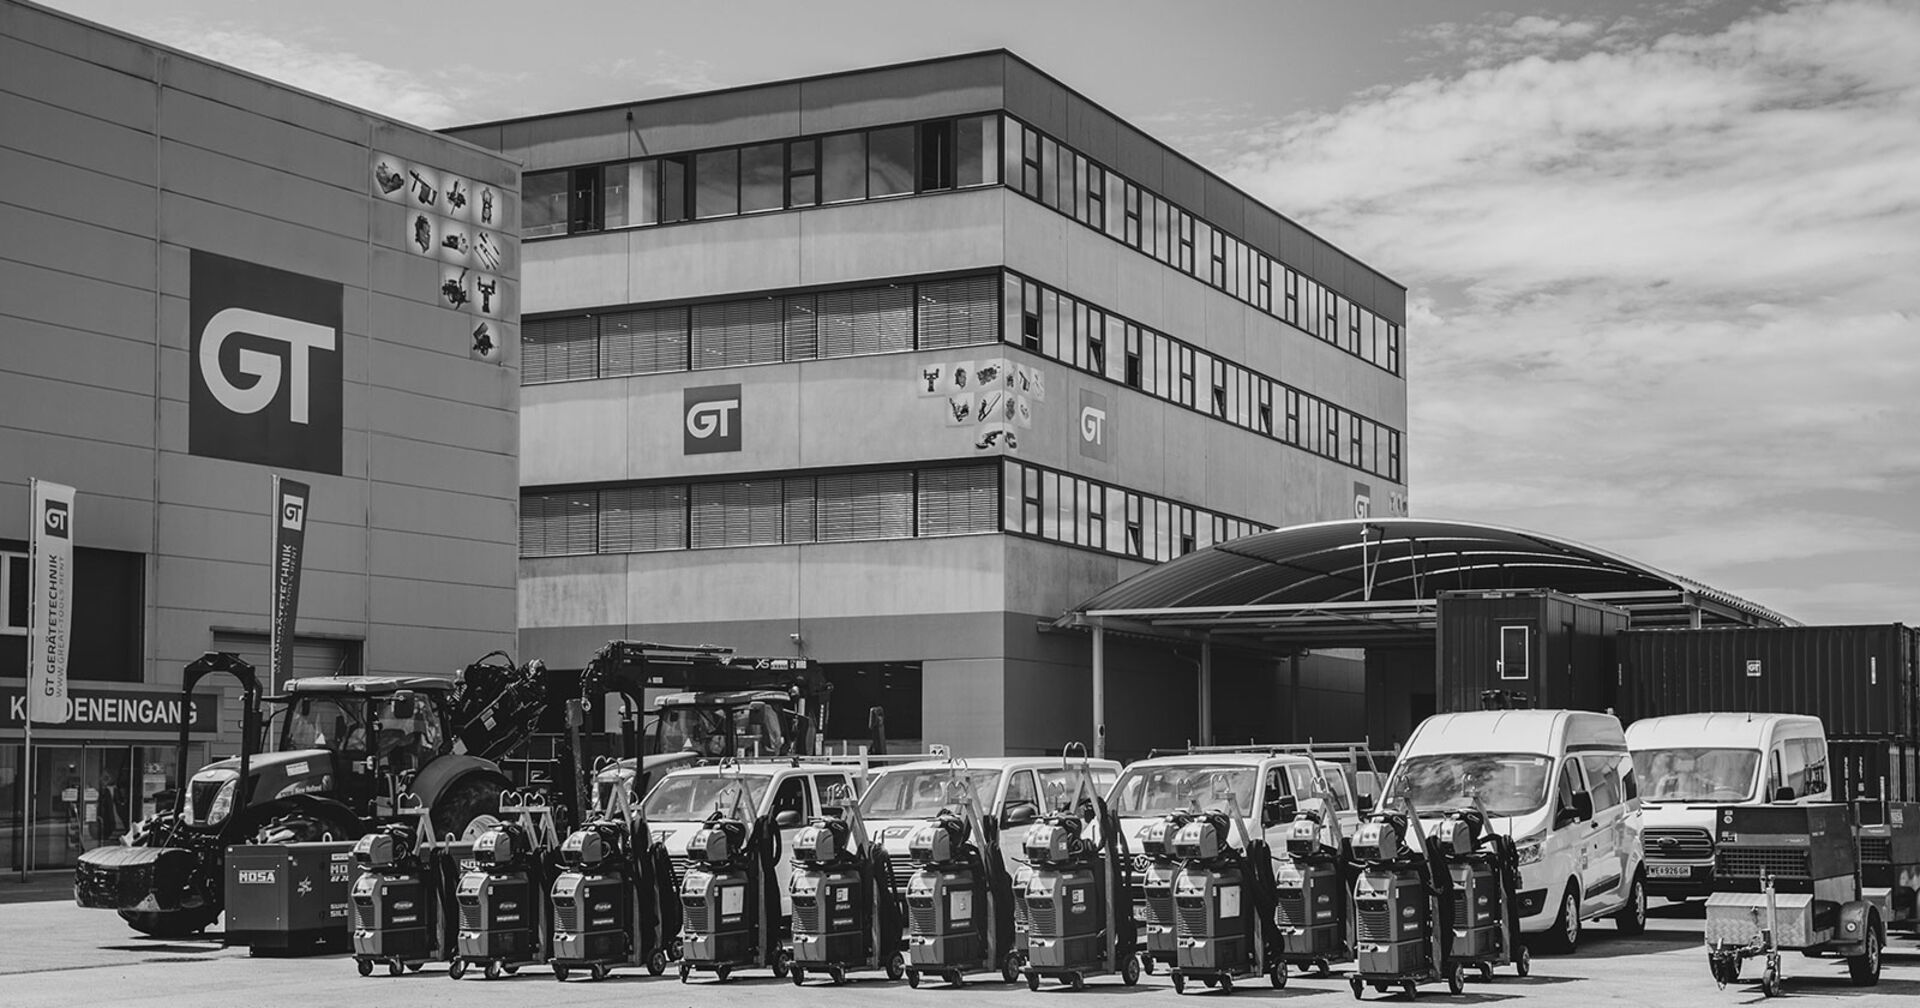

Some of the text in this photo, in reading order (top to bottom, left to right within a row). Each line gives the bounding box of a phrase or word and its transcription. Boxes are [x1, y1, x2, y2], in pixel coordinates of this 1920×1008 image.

[200, 307, 335, 424] GT
[685, 399, 738, 438] GT
[1081, 406, 1106, 445] GT
[46, 508, 67, 531] GT
[285, 503, 302, 522] GT
[1355, 494, 1370, 519] GT
[44, 554, 57, 697] GT GERÄTETECHNIK
[239, 870, 275, 884] MOSA
